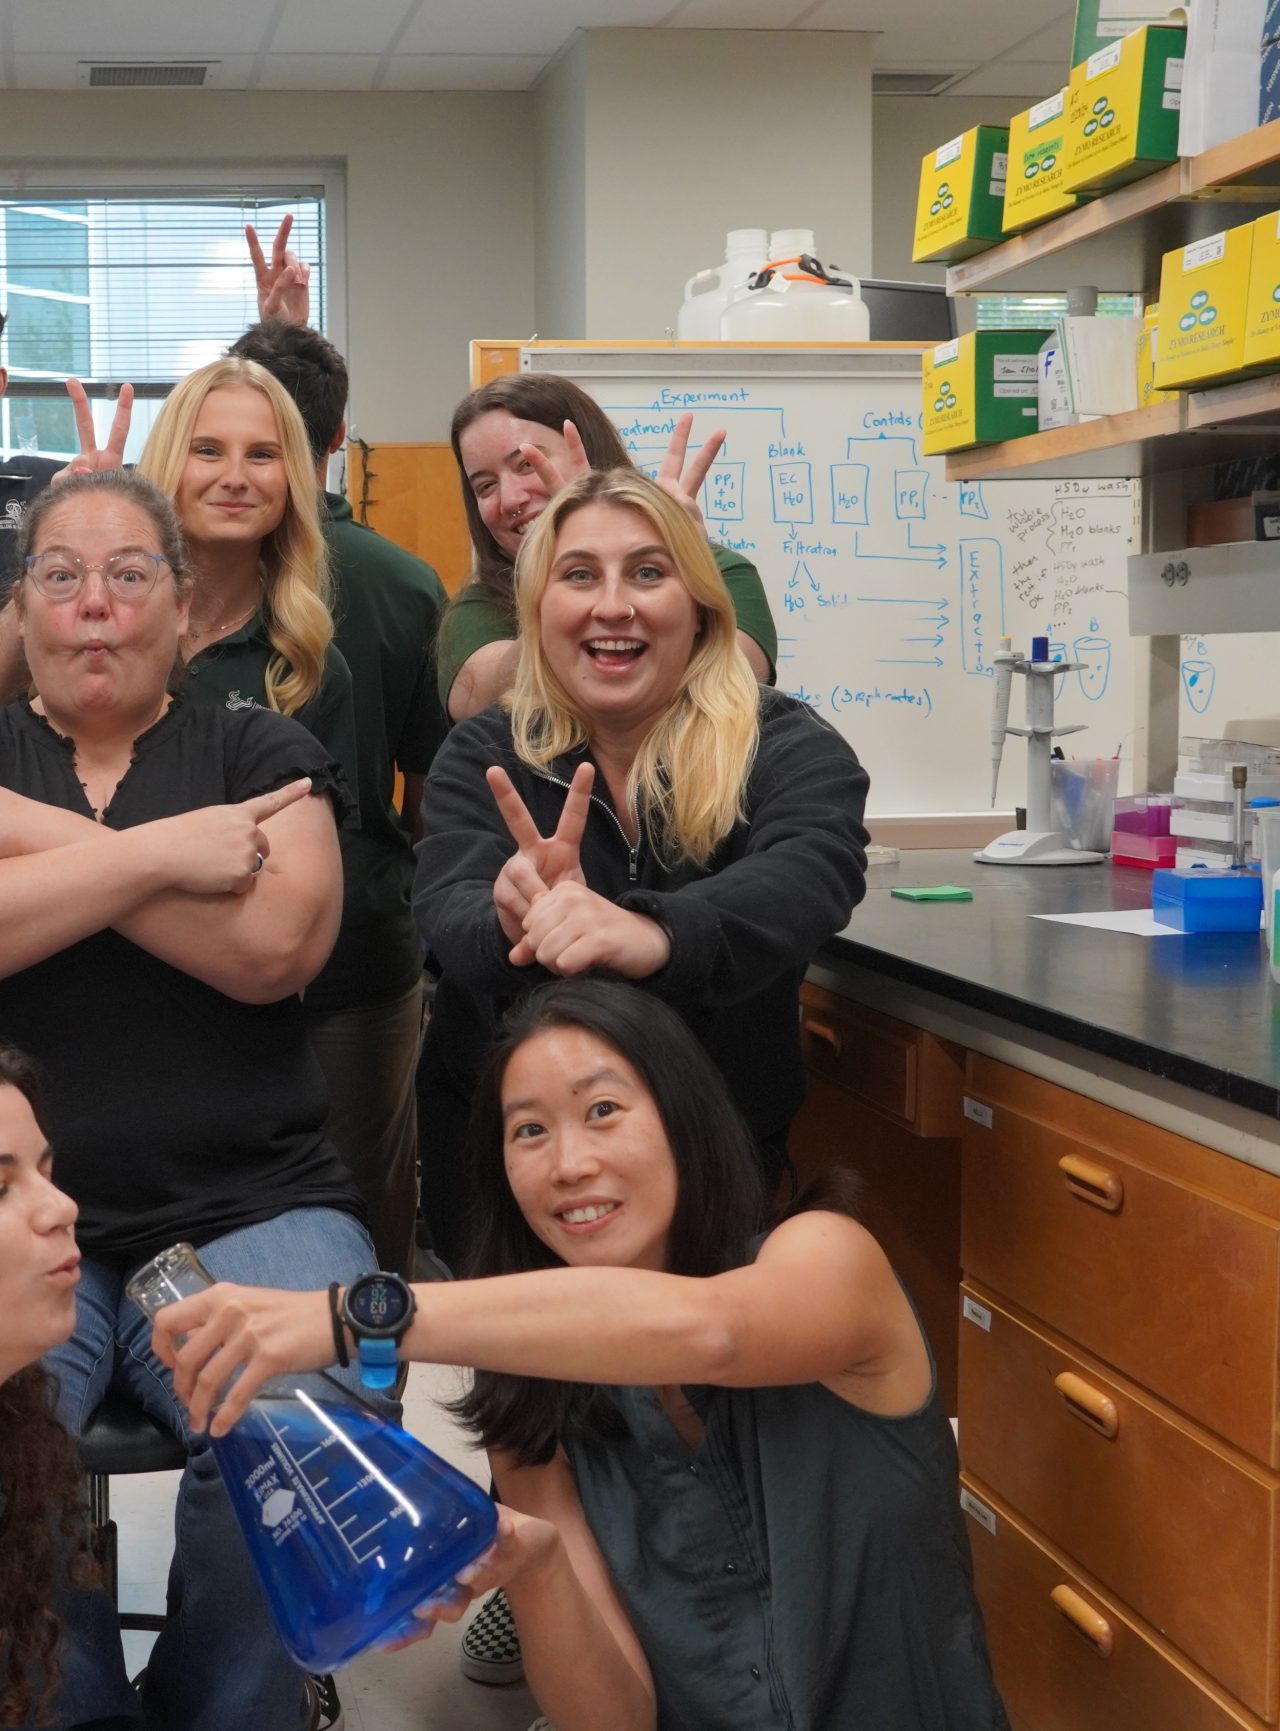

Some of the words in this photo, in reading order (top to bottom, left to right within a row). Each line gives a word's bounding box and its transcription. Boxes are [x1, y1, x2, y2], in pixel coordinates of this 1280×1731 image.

[661, 388, 749, 406] Experiment
[618, 418, 677, 437] reatment
[768, 441, 805, 458] Blank
